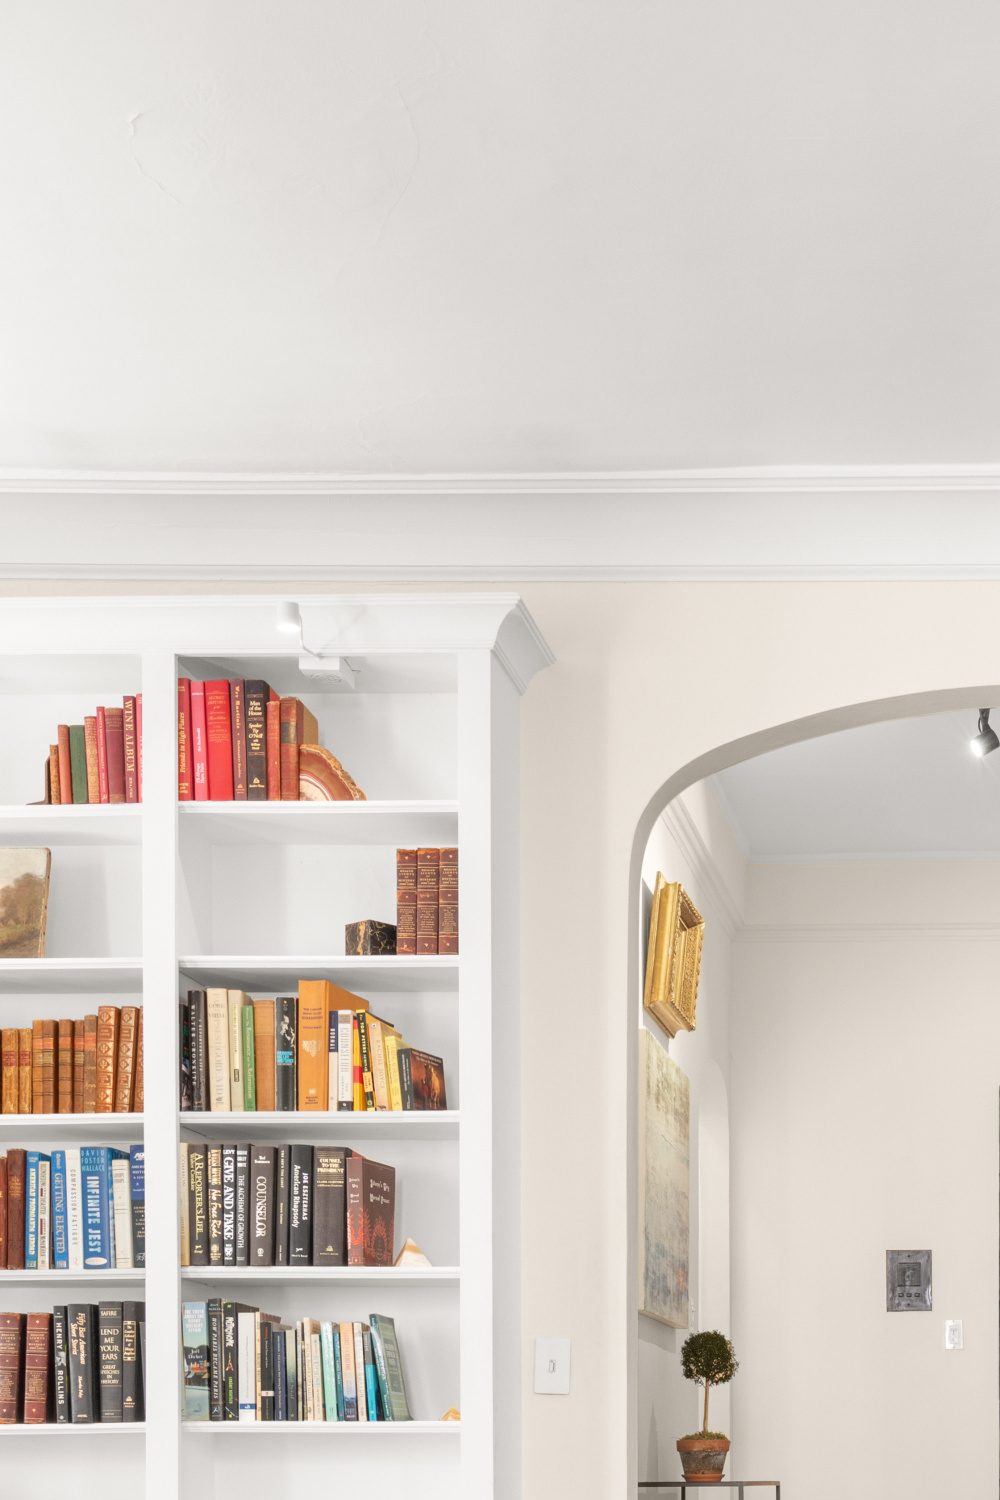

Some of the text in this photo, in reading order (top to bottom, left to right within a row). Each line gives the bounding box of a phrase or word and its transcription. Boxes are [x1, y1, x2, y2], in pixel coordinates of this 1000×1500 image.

[124, 699, 135, 772] WINE ALBUM
[340, 1027, 349, 1073] COUNSELOR
[55, 1173, 65, 1254] GETTING ELECTED
[86, 1176, 101, 1253] INFINITE JEST
[195, 1153, 205, 1233] A REPORTER'S LIFE
[211, 1189, 221, 1238] No Free Ride
[224, 1156, 234, 1240] GIVE AND TAKE
[256, 1176, 267, 1238] COUNSELOR
[291, 1164, 301, 1228] American Rhapsody
[70, 1322, 79, 1355] Short Stories
[76, 1312, 86, 1326] Fifty
[79, 1338, 87, 1365] American
[57, 1370, 65, 1405] ROLLINS
